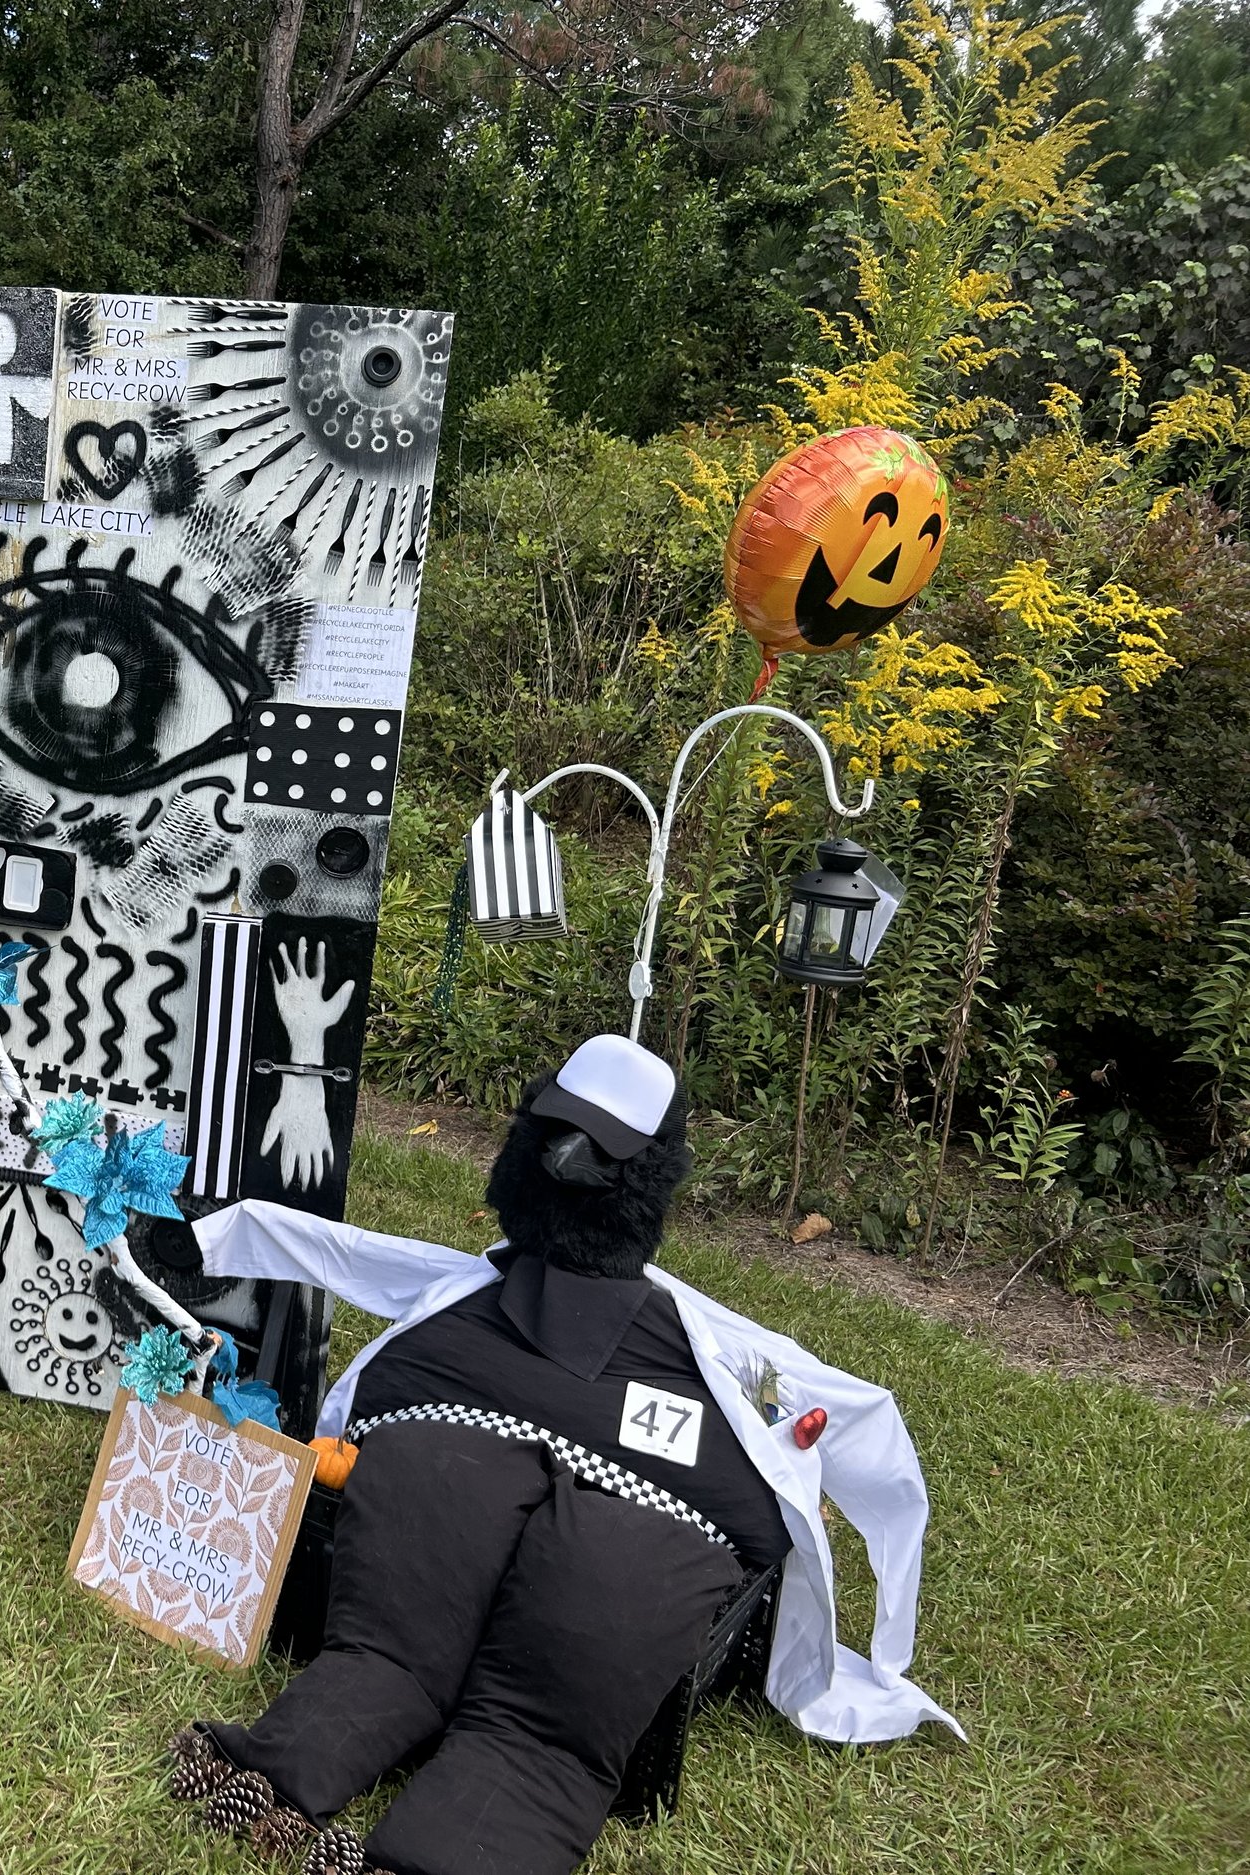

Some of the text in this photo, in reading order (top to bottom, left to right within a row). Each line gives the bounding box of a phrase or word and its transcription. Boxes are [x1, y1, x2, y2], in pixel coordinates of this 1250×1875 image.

[101, 299, 154, 320] VOTE
[105, 328, 144, 348] FOR
[74, 357, 181, 379] MR. & MRS.
[67, 381, 187, 402] RECY-CROW
[41, 504, 94, 529] LAKE
[100, 510, 153, 535] CITY.
[327, 604, 394, 616] #REDNECKLOOTLLC
[312, 618, 405, 632] #RECYCLELAKECITYFLORIDA
[325, 634, 390, 646] #RECYCLELAKECITY
[325, 650, 385, 661] #RECYCLEPEOPLE
[299, 663, 408, 678] #RECYCLEREPURPOSEREIMAGINE
[333, 680, 370, 690] #MAKEART
[306, 693, 393, 707] #MSSANDRASARTCLASSES
[630, 1400, 692, 1444] 47
[185, 1429, 234, 1467] VOTE
[173, 1480, 213, 1513] FOR
[132, 1511, 231, 1578] MR. & MRS.
[119, 1534, 234, 1604] RECY-CROW
